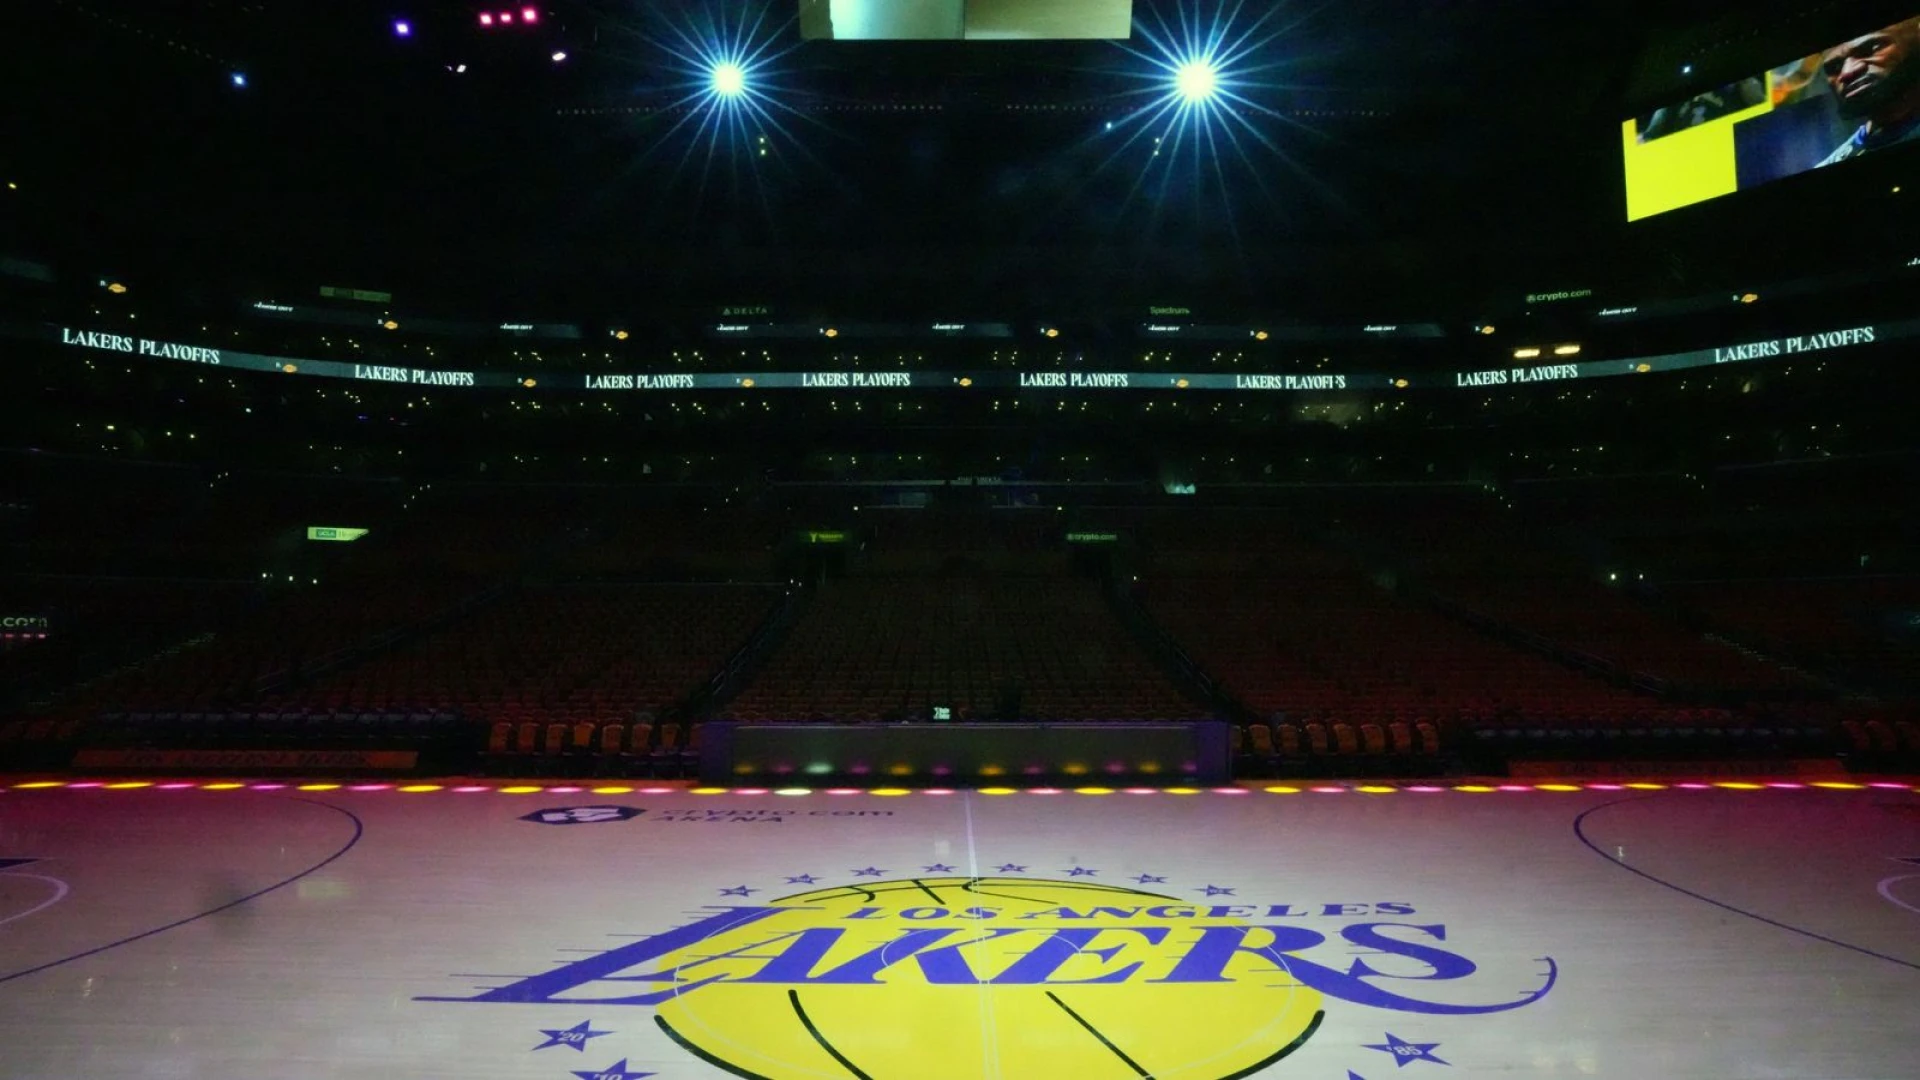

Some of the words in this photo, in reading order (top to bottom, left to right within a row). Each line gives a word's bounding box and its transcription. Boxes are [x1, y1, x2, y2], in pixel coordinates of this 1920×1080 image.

[1536, 289, 1592, 302] crypto.com
[733, 307, 768, 315] DELTA
[63, 328, 133, 352] LAKERS
[139, 339, 220, 365] PLAYOFFS
[1715, 340, 1780, 363] LAKERS
[1786, 326, 1875, 353] PLAYOFFS
[354, 364, 407, 382] LAKERS
[412, 369, 474, 386] PLAYOFFS
[585, 374, 634, 389] LAKERS
[636, 374, 694, 389] PLAYOFFS
[802, 372, 849, 387] LAKERS
[852, 372, 911, 387] PLAYOFFS
[1020, 372, 1067, 387] LAKERS
[1070, 372, 1129, 387] PLAYOFFS
[1236, 374, 1282, 389] LAKERS
[1457, 370, 1508, 387] LAKERS
[1511, 364, 1578, 383] PLAYOFFS
[839, 906, 1001, 920] LOS
[1014, 901, 1417, 919] ANGELES
[413, 905, 1557, 1015] LAKERS
